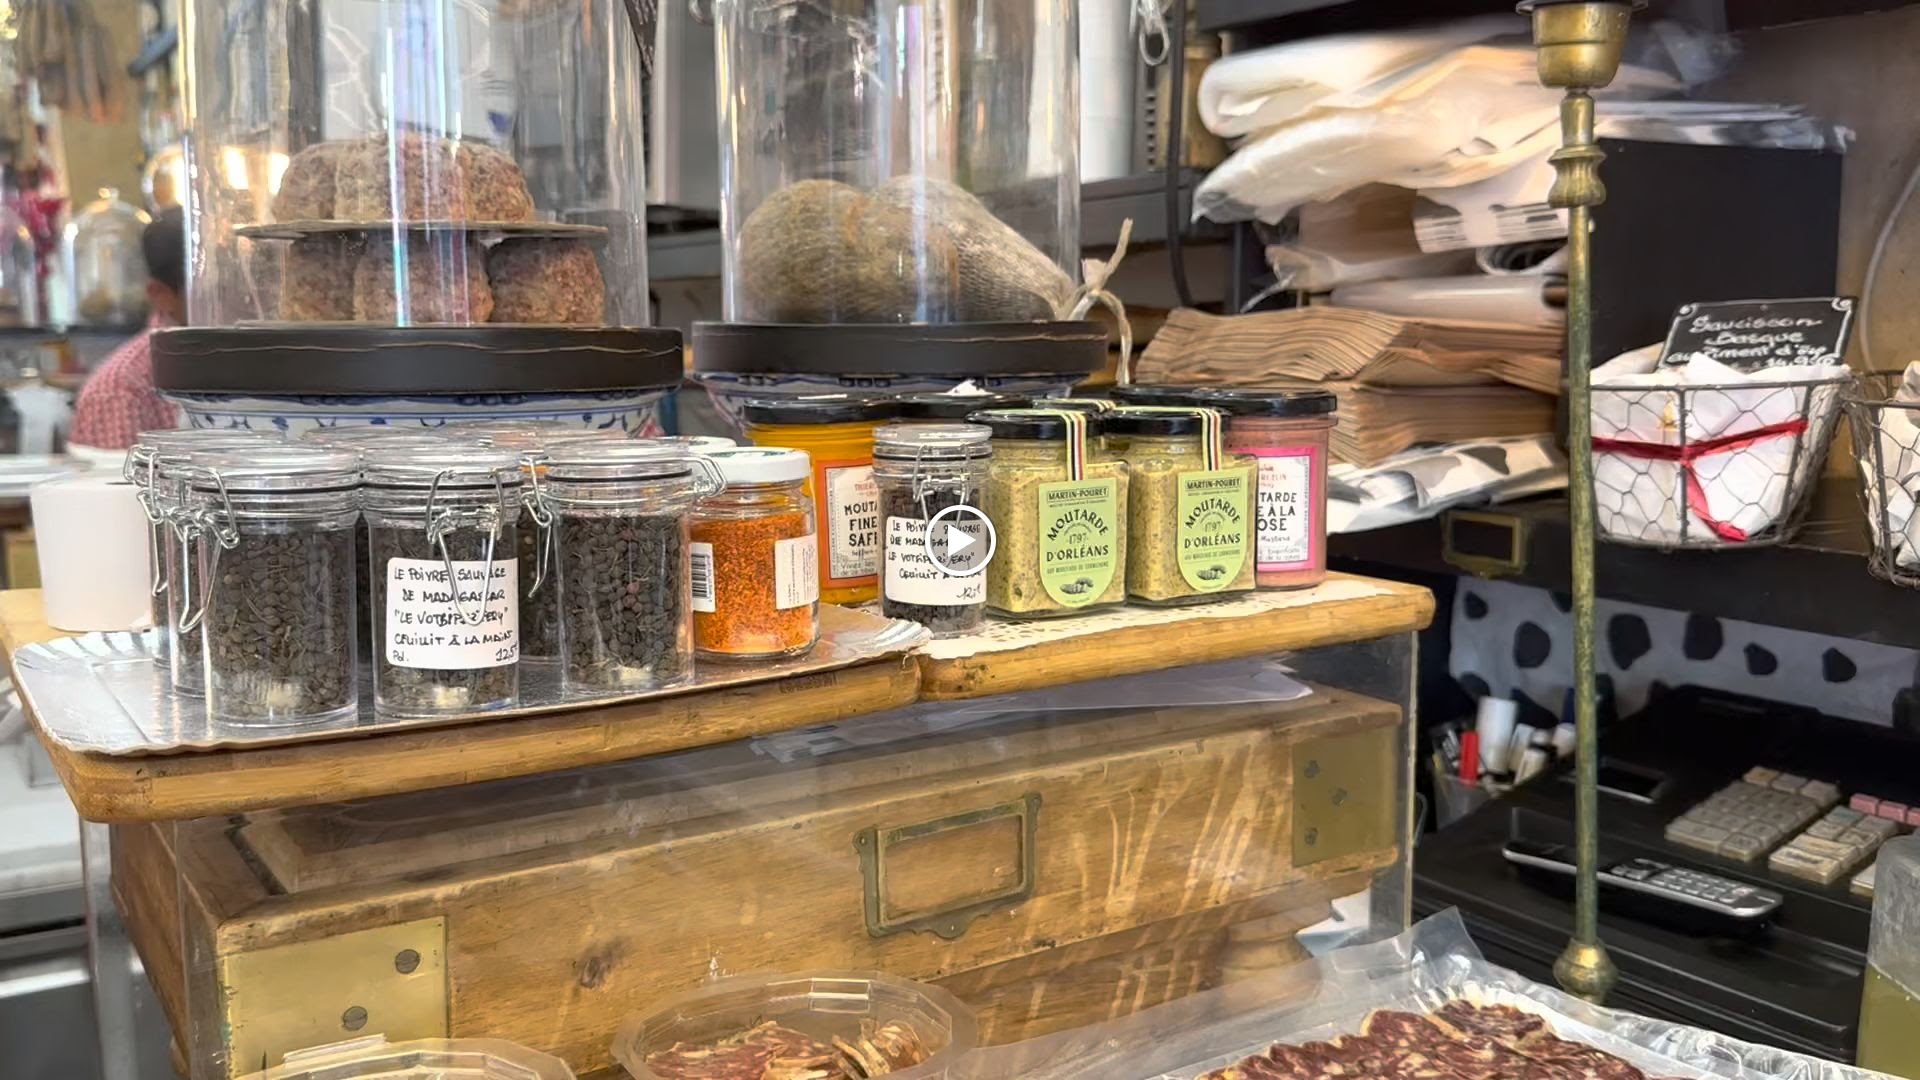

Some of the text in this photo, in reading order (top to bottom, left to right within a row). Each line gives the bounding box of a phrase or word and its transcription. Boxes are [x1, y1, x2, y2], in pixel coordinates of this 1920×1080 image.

[1186, 478, 1240, 490] MARTIN-POURET
[1048, 487, 1108, 500] MARTIN-POURET
[1259, 491, 1297, 503] TARDE
[1185, 498, 1241, 529] MOUTARDE
[1280, 505, 1296, 517] LA
[848, 516, 877, 531] FINE
[1046, 508, 1109, 541] MOUTARDE
[1257, 517, 1287, 532] OSE
[1185, 532, 1241, 549] D'ORLÉANS
[1046, 544, 1109, 562] D'ORLÉANS
[394, 569, 405, 580] LE
[402, 588, 415, 602] DE
[464, 634, 480, 645] LA
